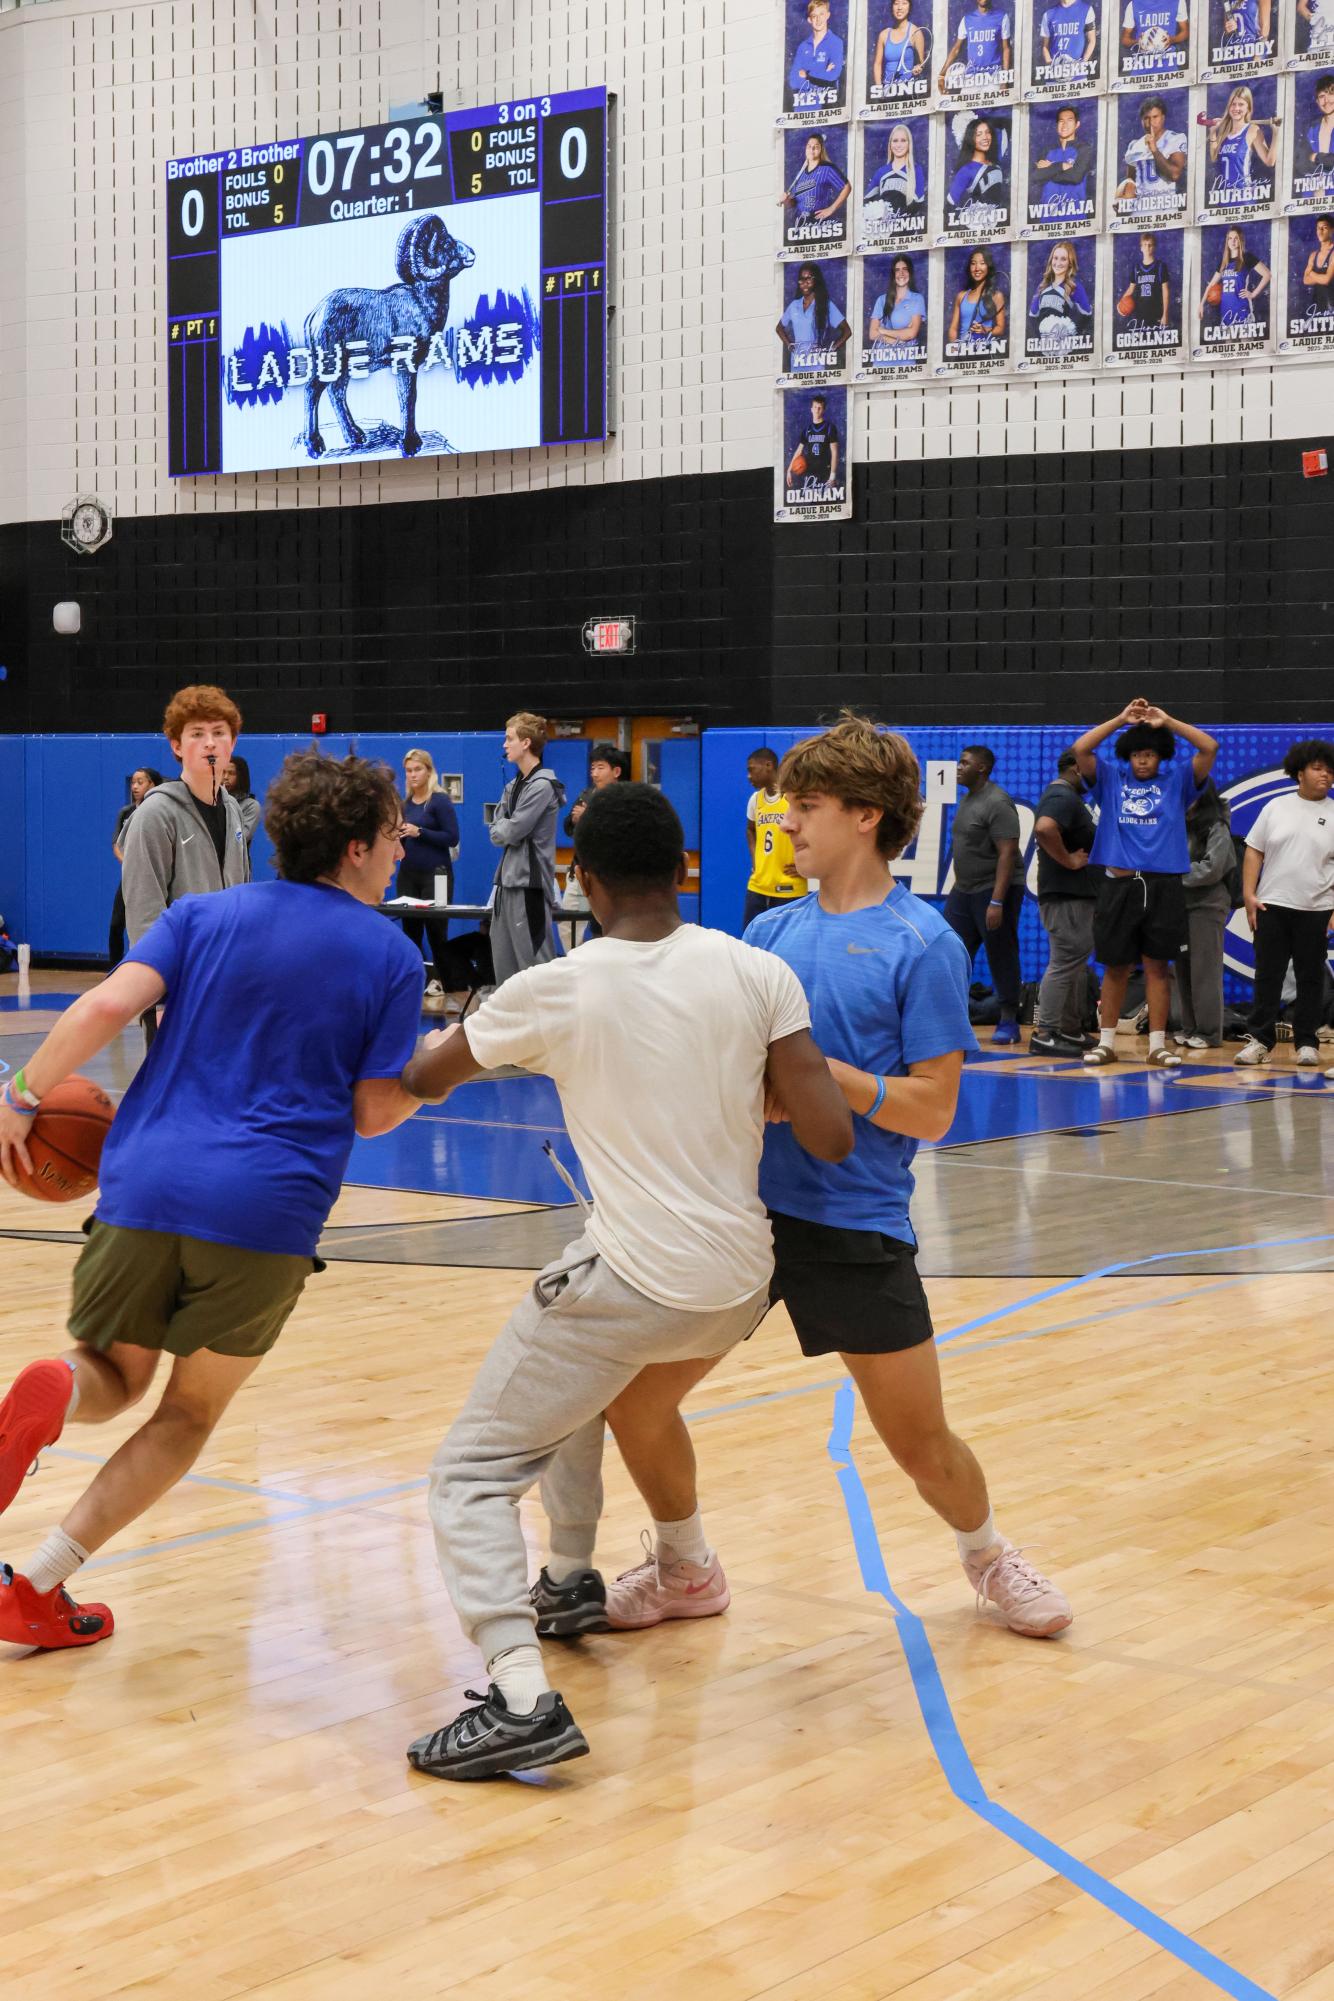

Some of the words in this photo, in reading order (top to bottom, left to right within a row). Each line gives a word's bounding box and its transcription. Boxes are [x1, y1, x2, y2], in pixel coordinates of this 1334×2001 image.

[1140, 12, 1170, 27] LADUE
[968, 29, 996, 43] LADUE
[1053, 22, 1079, 36] LADUE
[977, 44, 984, 57] 3
[1058, 37, 1070, 51] 47
[1212, 40, 1275, 62] DERDOY
[1122, 51, 1185, 72] BHUTTO
[1299, 52, 1330, 62] LADUE
[1035, 60, 1098, 80] PROSKEY
[1213, 65, 1244, 74] LADUE
[1247, 60, 1274, 70] RAMS
[1123, 75, 1154, 85] LADUE
[1157, 72, 1185, 82] RAMS
[870, 80, 928, 99] SONG
[1036, 85, 1066, 94] LADUE
[1070, 81, 1096, 91] RAMS
[793, 89, 838, 107] KEYS
[951, 94, 981, 103] LADUE
[983, 90, 1010, 100] RAMS
[499, 105, 509, 124] 3
[514, 103, 536, 121] on
[541, 97, 551, 117] 3
[870, 103, 900, 112] LADUE
[902, 100, 927, 109] RAMS
[787, 111, 816, 120] LADUE
[818, 109, 842, 117] RAMS
[471, 131, 482, 152] 0
[490, 126, 536, 148] FOULS
[308, 122, 442, 196] 07:32
[486, 147, 536, 169] BONUS
[560, 127, 587, 179] 0
[168, 157, 224, 179] Brother
[228, 151, 237, 169] 2
[242, 144, 299, 167] Brother
[226, 171, 266, 191] FOULS
[274, 165, 284, 184] 0
[471, 173, 482, 194] 5
[508, 168, 536, 186] TOL
[1294, 174, 1334, 193] THOMA
[226, 190, 270, 210] BONUS
[1208, 184, 1271, 204] DURBIN
[1296, 197, 1329, 206] LADUE
[330, 195, 399, 220] Quarter:
[406, 189, 413, 209] 1
[1118, 193, 1187, 213] HENDERSON
[1209, 207, 1240, 217] LADUE
[1243, 203, 1270, 213] RAMS
[182, 190, 204, 237] 0
[226, 213, 250, 229] TOL
[274, 204, 284, 224] 5
[1122, 216, 1152, 224] LADUE
[1156, 213, 1182, 222] RAMS
[788, 223, 843, 241] CROSS
[865, 216, 925, 235] STONEMAN
[948, 230, 977, 239] LADUE
[981, 228, 1006, 237] RAMS
[1032, 223, 1062, 231] LADUE
[1065, 220, 1091, 230] RAMS
[867, 238, 896, 247] LADUE
[899, 236, 923, 245] RAMS
[1048, 230, 1076, 238] 2025-2026
[788, 245, 817, 254] LADUE
[820, 243, 842, 251] RAMS
[565, 271, 584, 288] PT
[593, 270, 600, 287] f
[1223, 279, 1235, 293] 22
[187, 320, 203, 336] PT
[209, 320, 215, 335] f
[1204, 322, 1266, 341] CALVERT
[1117, 329, 1179, 348] GOELLNER
[1293, 337, 1322, 346] LADUE
[862, 345, 928, 363] STOCKWELL
[945, 340, 1007, 357] CHEN
[1118, 351, 1148, 360] LADUE
[1151, 349, 1176, 357] RAMS
[1206, 344, 1235, 353] LADUE
[1238, 342, 1264, 351] RAMS
[230, 340, 369, 392] LADUE
[391, 323, 523, 375] RAMS
[793, 352, 838, 367] KING
[947, 361, 977, 370] LADUE
[980, 360, 1005, 369] RAMS
[1030, 356, 1060, 365] LADUE
[1063, 355, 1089, 364] RAMS
[787, 372, 814, 380] LADUE
[817, 370, 842, 379] RAMS
[866, 367, 895, 375] LADUE
[898, 366, 923, 374] RAMS
[812, 443, 820, 455] 4
[787, 487, 845, 503] OLDHAM
[790, 507, 817, 515] LADUE
[820, 505, 842, 513] RAMS
[600, 624, 619, 648] EXIT
[937, 769, 945, 785] 1
[757, 812, 785, 827] LAKERS
[764, 830, 773, 853] 6
